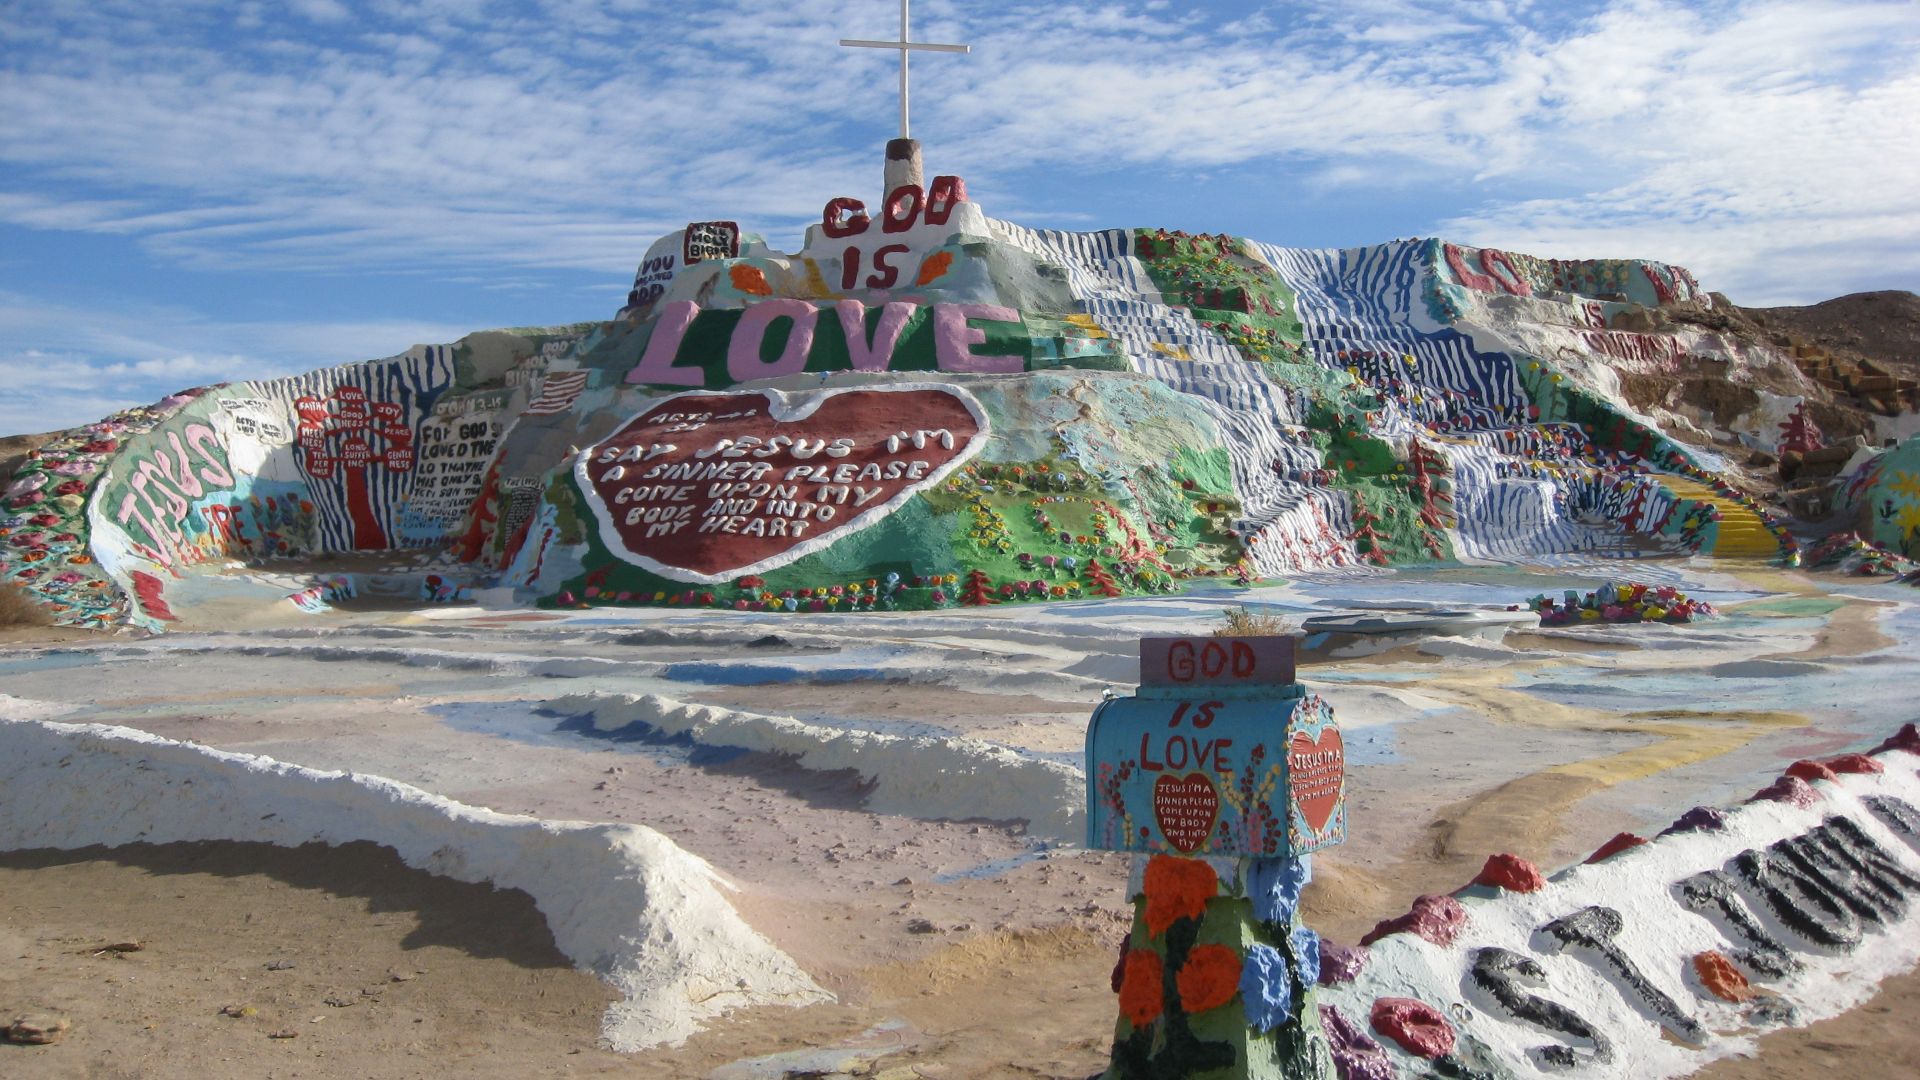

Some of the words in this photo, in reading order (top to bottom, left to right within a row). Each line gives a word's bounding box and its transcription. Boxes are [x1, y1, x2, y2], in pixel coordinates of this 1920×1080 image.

[822, 175, 969, 238] GOD
[692, 233, 729, 246] HOLY
[642, 255, 675, 275] YOU
[842, 244, 909, 290] IS
[623, 299, 1025, 386] LOVE
[299, 401, 322, 410] FAITH
[340, 391, 362, 400] LOVE
[378, 406, 400, 417] JOY
[648, 411, 712, 423] ACTS
[459, 422, 487, 440] GOD
[421, 443, 468, 460] LOVED
[470, 440, 497, 458] THE
[598, 443, 677, 465] SAY
[695, 435, 855, 460] JESUS
[887, 429, 954, 454] I'M
[441, 474, 471, 486] ONLY
[600, 465, 625, 482] A
[643, 459, 773, 481] SINNER
[784, 460, 929, 483] PLEASE
[117, 424, 233, 564] JESUS
[615, 485, 697, 504] COME
[708, 482, 799, 500] UPON
[817, 485, 882, 507] MY
[702, 498, 757, 517] AND
[766, 499, 835, 522] INTO
[646, 520, 690, 538] MY
[699, 516, 809, 538] HEART
[1168, 640, 1256, 682] GOD
[1168, 700, 1225, 728] IS
[1140, 733, 1233, 773] LOVE
[1294, 751, 1321, 770] JESUS
[1335, 748, 1340, 762] A
[1158, 784, 1185, 793] JESUS
[1189, 783, 1201, 792] I'M
[1203, 785, 1211, 793] A
[1157, 796, 1187, 806] SINNER
[1190, 797, 1215, 807] PLEASE
[1160, 807, 1182, 816] COME
[1187, 809, 1211, 817] UPON
[1180, 818, 1207, 827] BODY
[1189, 829, 1207, 837] INTO
[1179, 839, 1195, 849] MY
